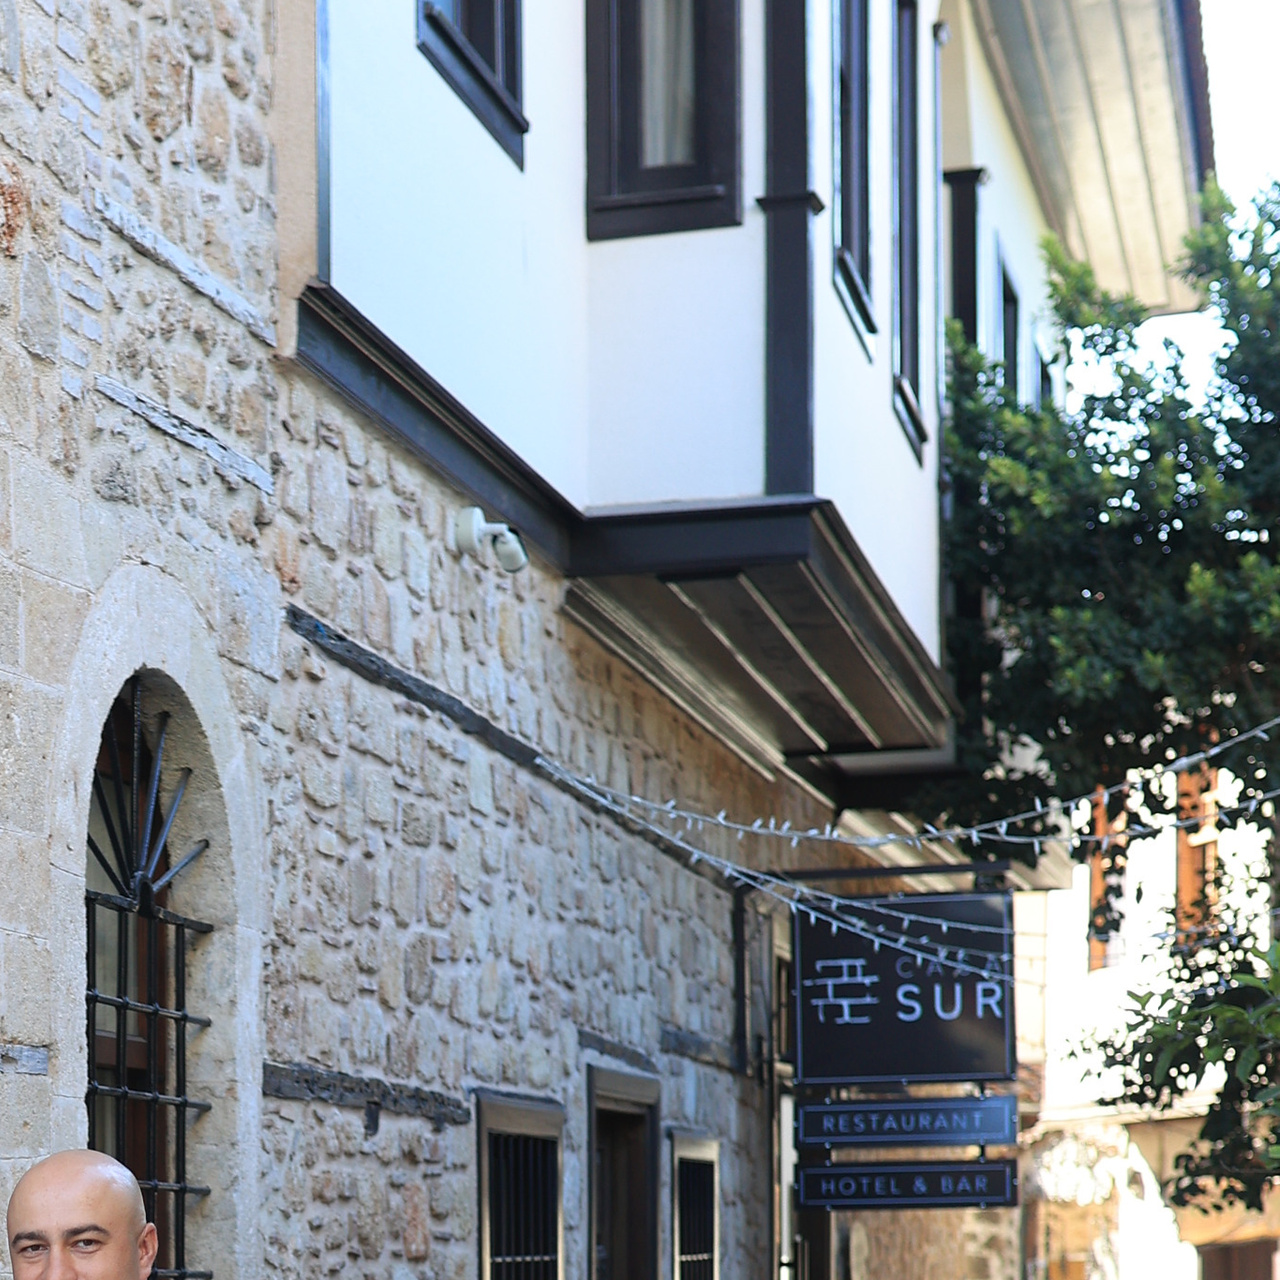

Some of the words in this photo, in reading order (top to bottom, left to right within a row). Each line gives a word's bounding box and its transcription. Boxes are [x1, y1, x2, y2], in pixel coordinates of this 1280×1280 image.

[896, 981, 1002, 1022] SUR
[822, 1112, 983, 1133] RESTAURANT
[820, 1175, 900, 1196] HOTEL
[913, 1175, 928, 1194] &
[940, 1174, 988, 1195] BAR
